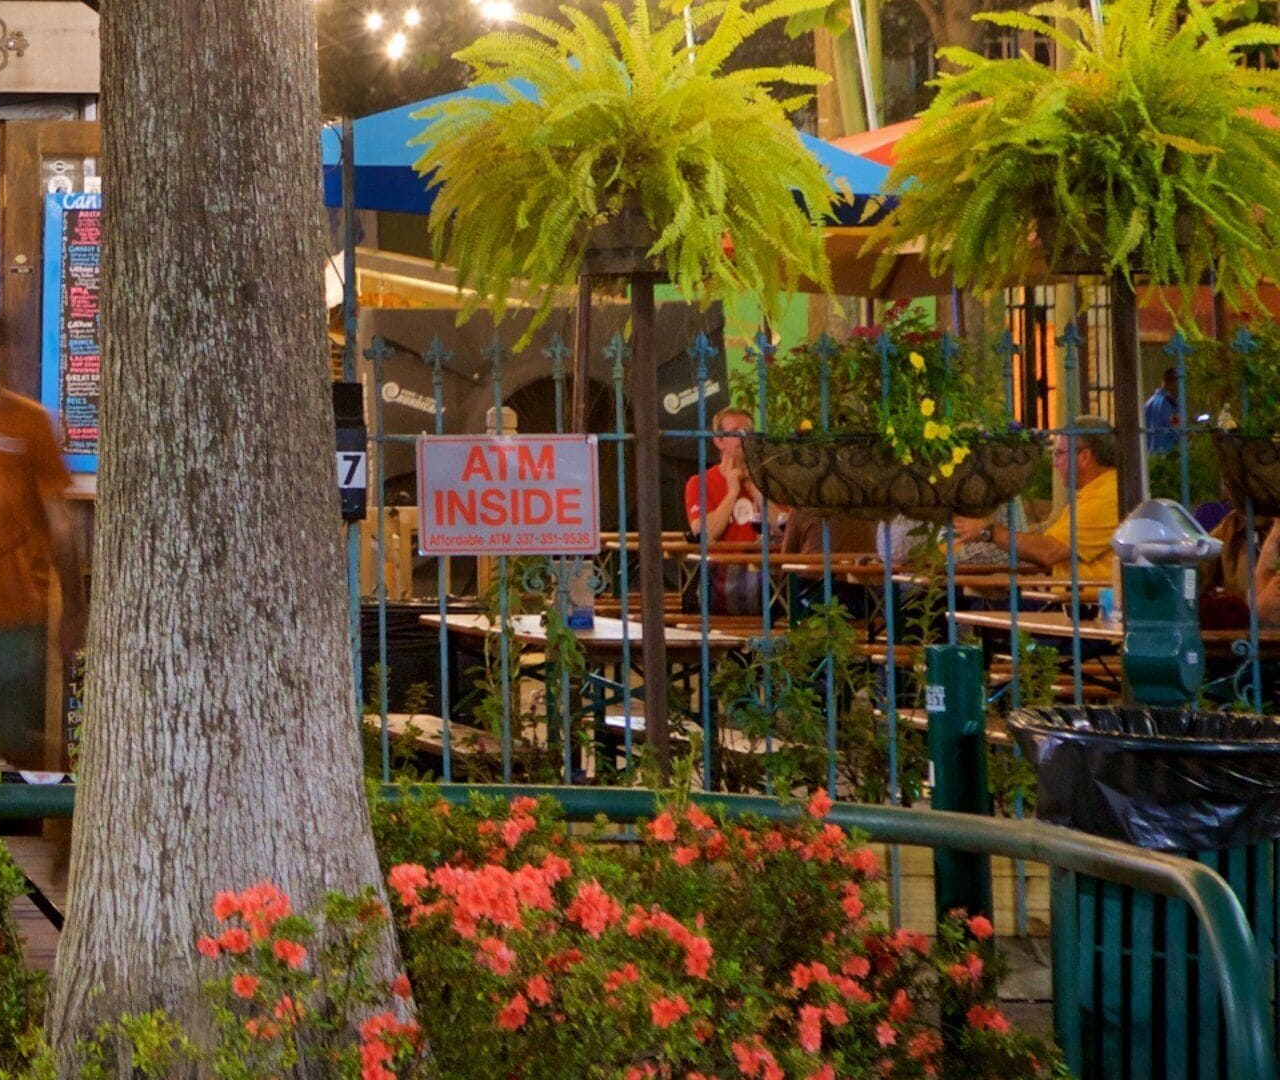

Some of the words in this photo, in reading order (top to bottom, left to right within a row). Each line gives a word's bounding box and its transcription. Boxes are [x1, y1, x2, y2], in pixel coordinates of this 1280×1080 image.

[342, 455, 362, 486] 7
[460, 444, 556, 482] ATM
[433, 487, 584, 527] INSIDE
[429, 534, 484, 546] Affordable
[487, 533, 511, 545] ATM
